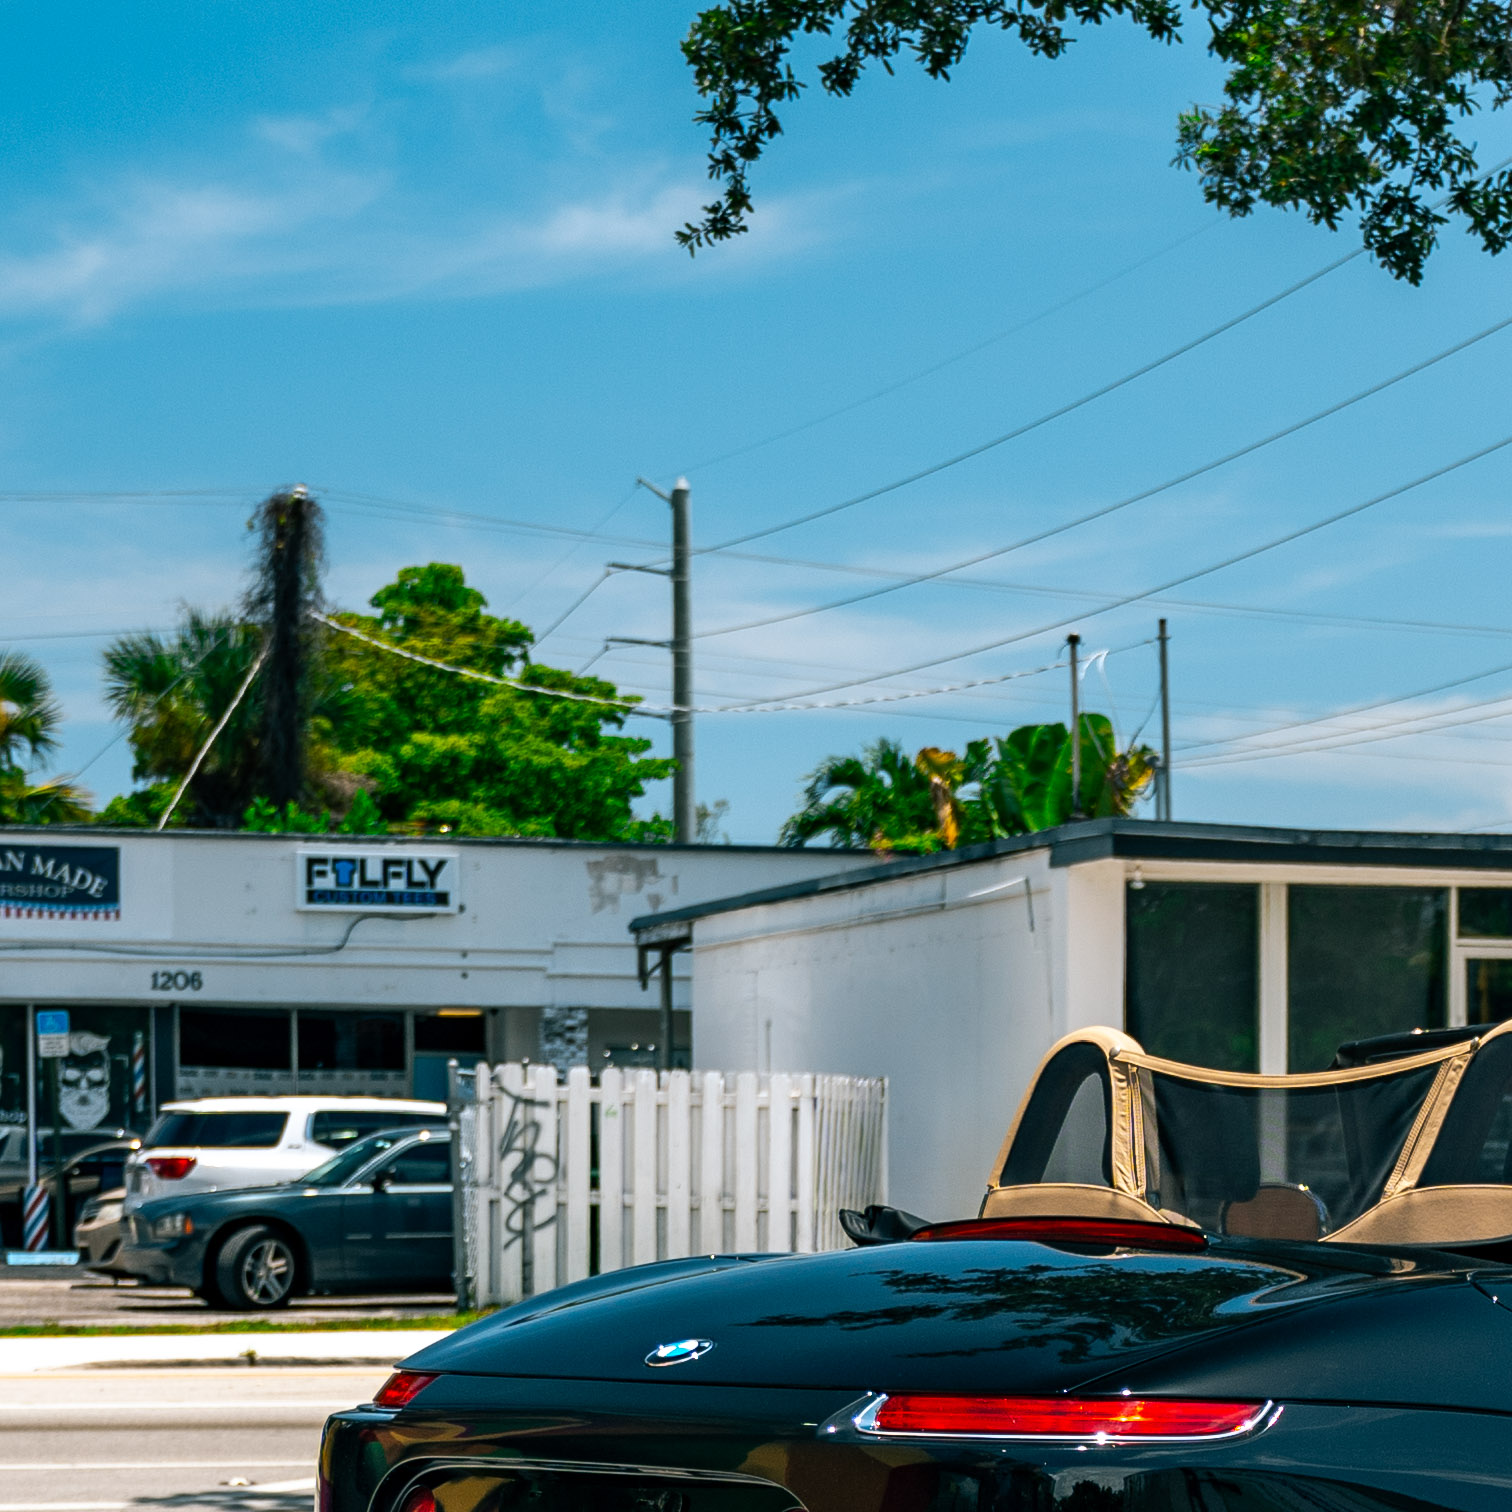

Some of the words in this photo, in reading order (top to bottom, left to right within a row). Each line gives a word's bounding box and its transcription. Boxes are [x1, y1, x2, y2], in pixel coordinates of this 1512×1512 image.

[31, 854, 109, 898] MADE
[312, 889, 387, 904] CUSTOM
[151, 971, 203, 991] 1206
